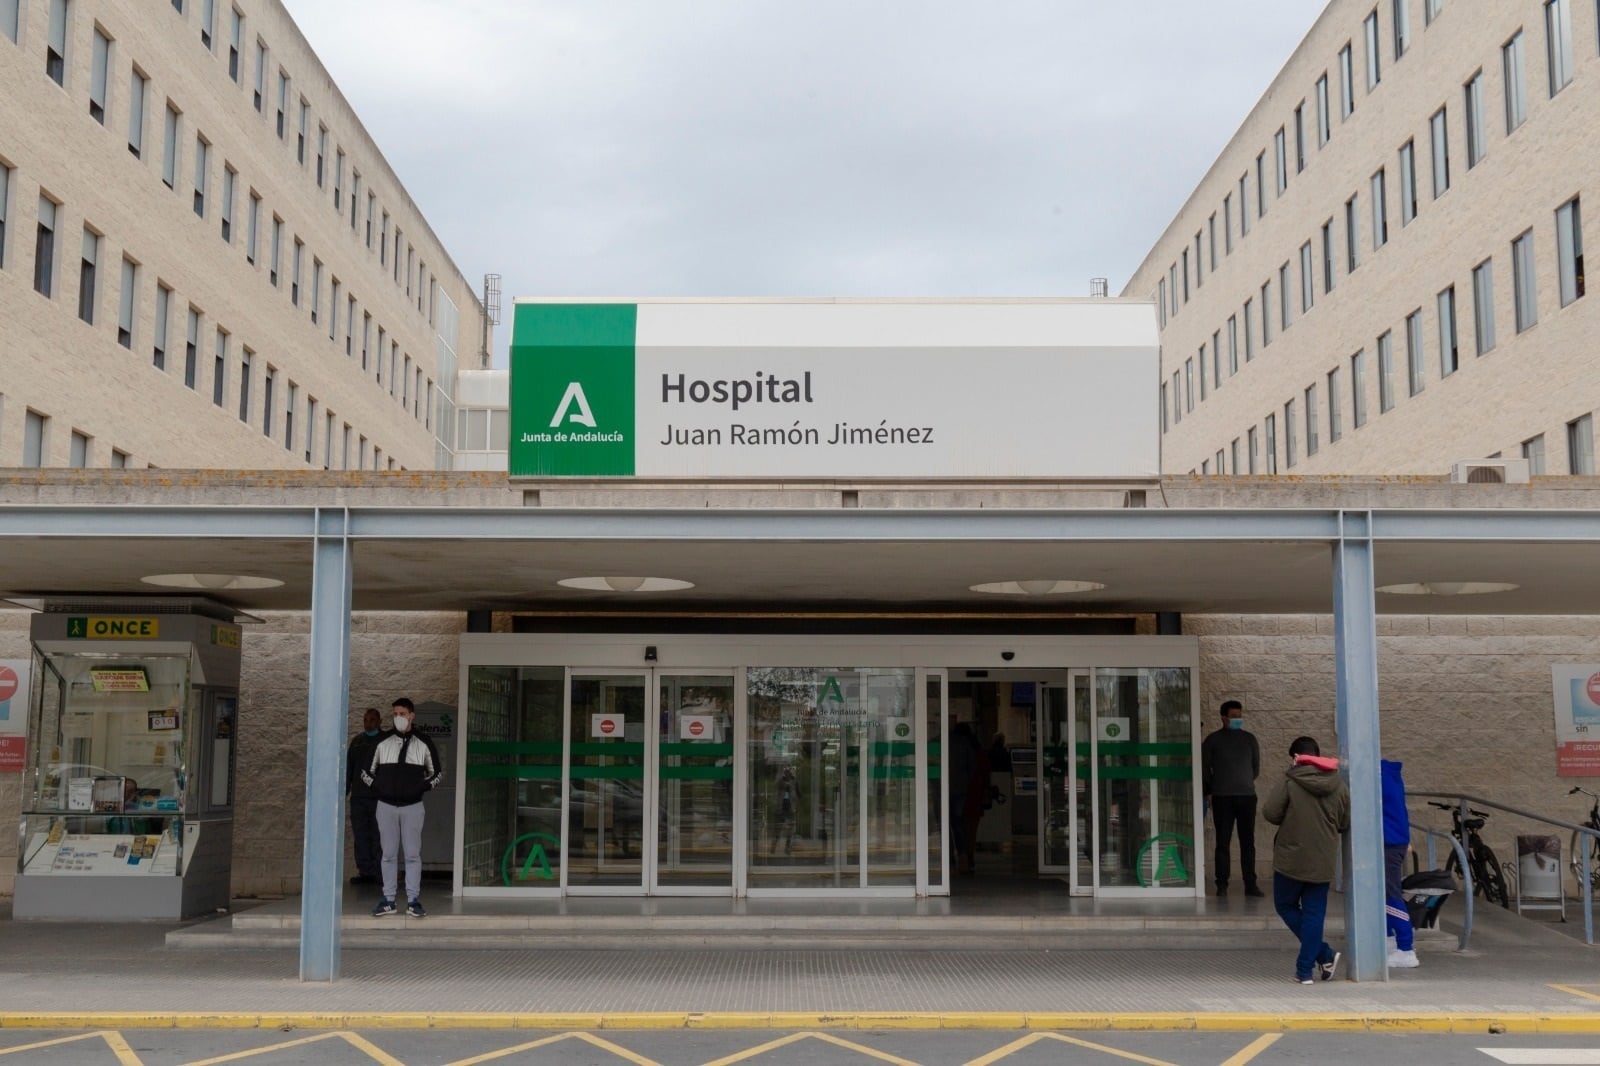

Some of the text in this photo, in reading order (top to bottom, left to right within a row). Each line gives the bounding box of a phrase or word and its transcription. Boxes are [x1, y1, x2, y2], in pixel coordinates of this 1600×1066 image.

[661, 372, 813, 410] Hospital
[520, 431, 623, 443] Junta de Andalucía
[660, 420, 934, 446] Juan Ramón Jiménez
[94, 620, 152, 635] ONCE
[219, 629, 238, 645] ONCE
[1575, 723, 1589, 733] sin
